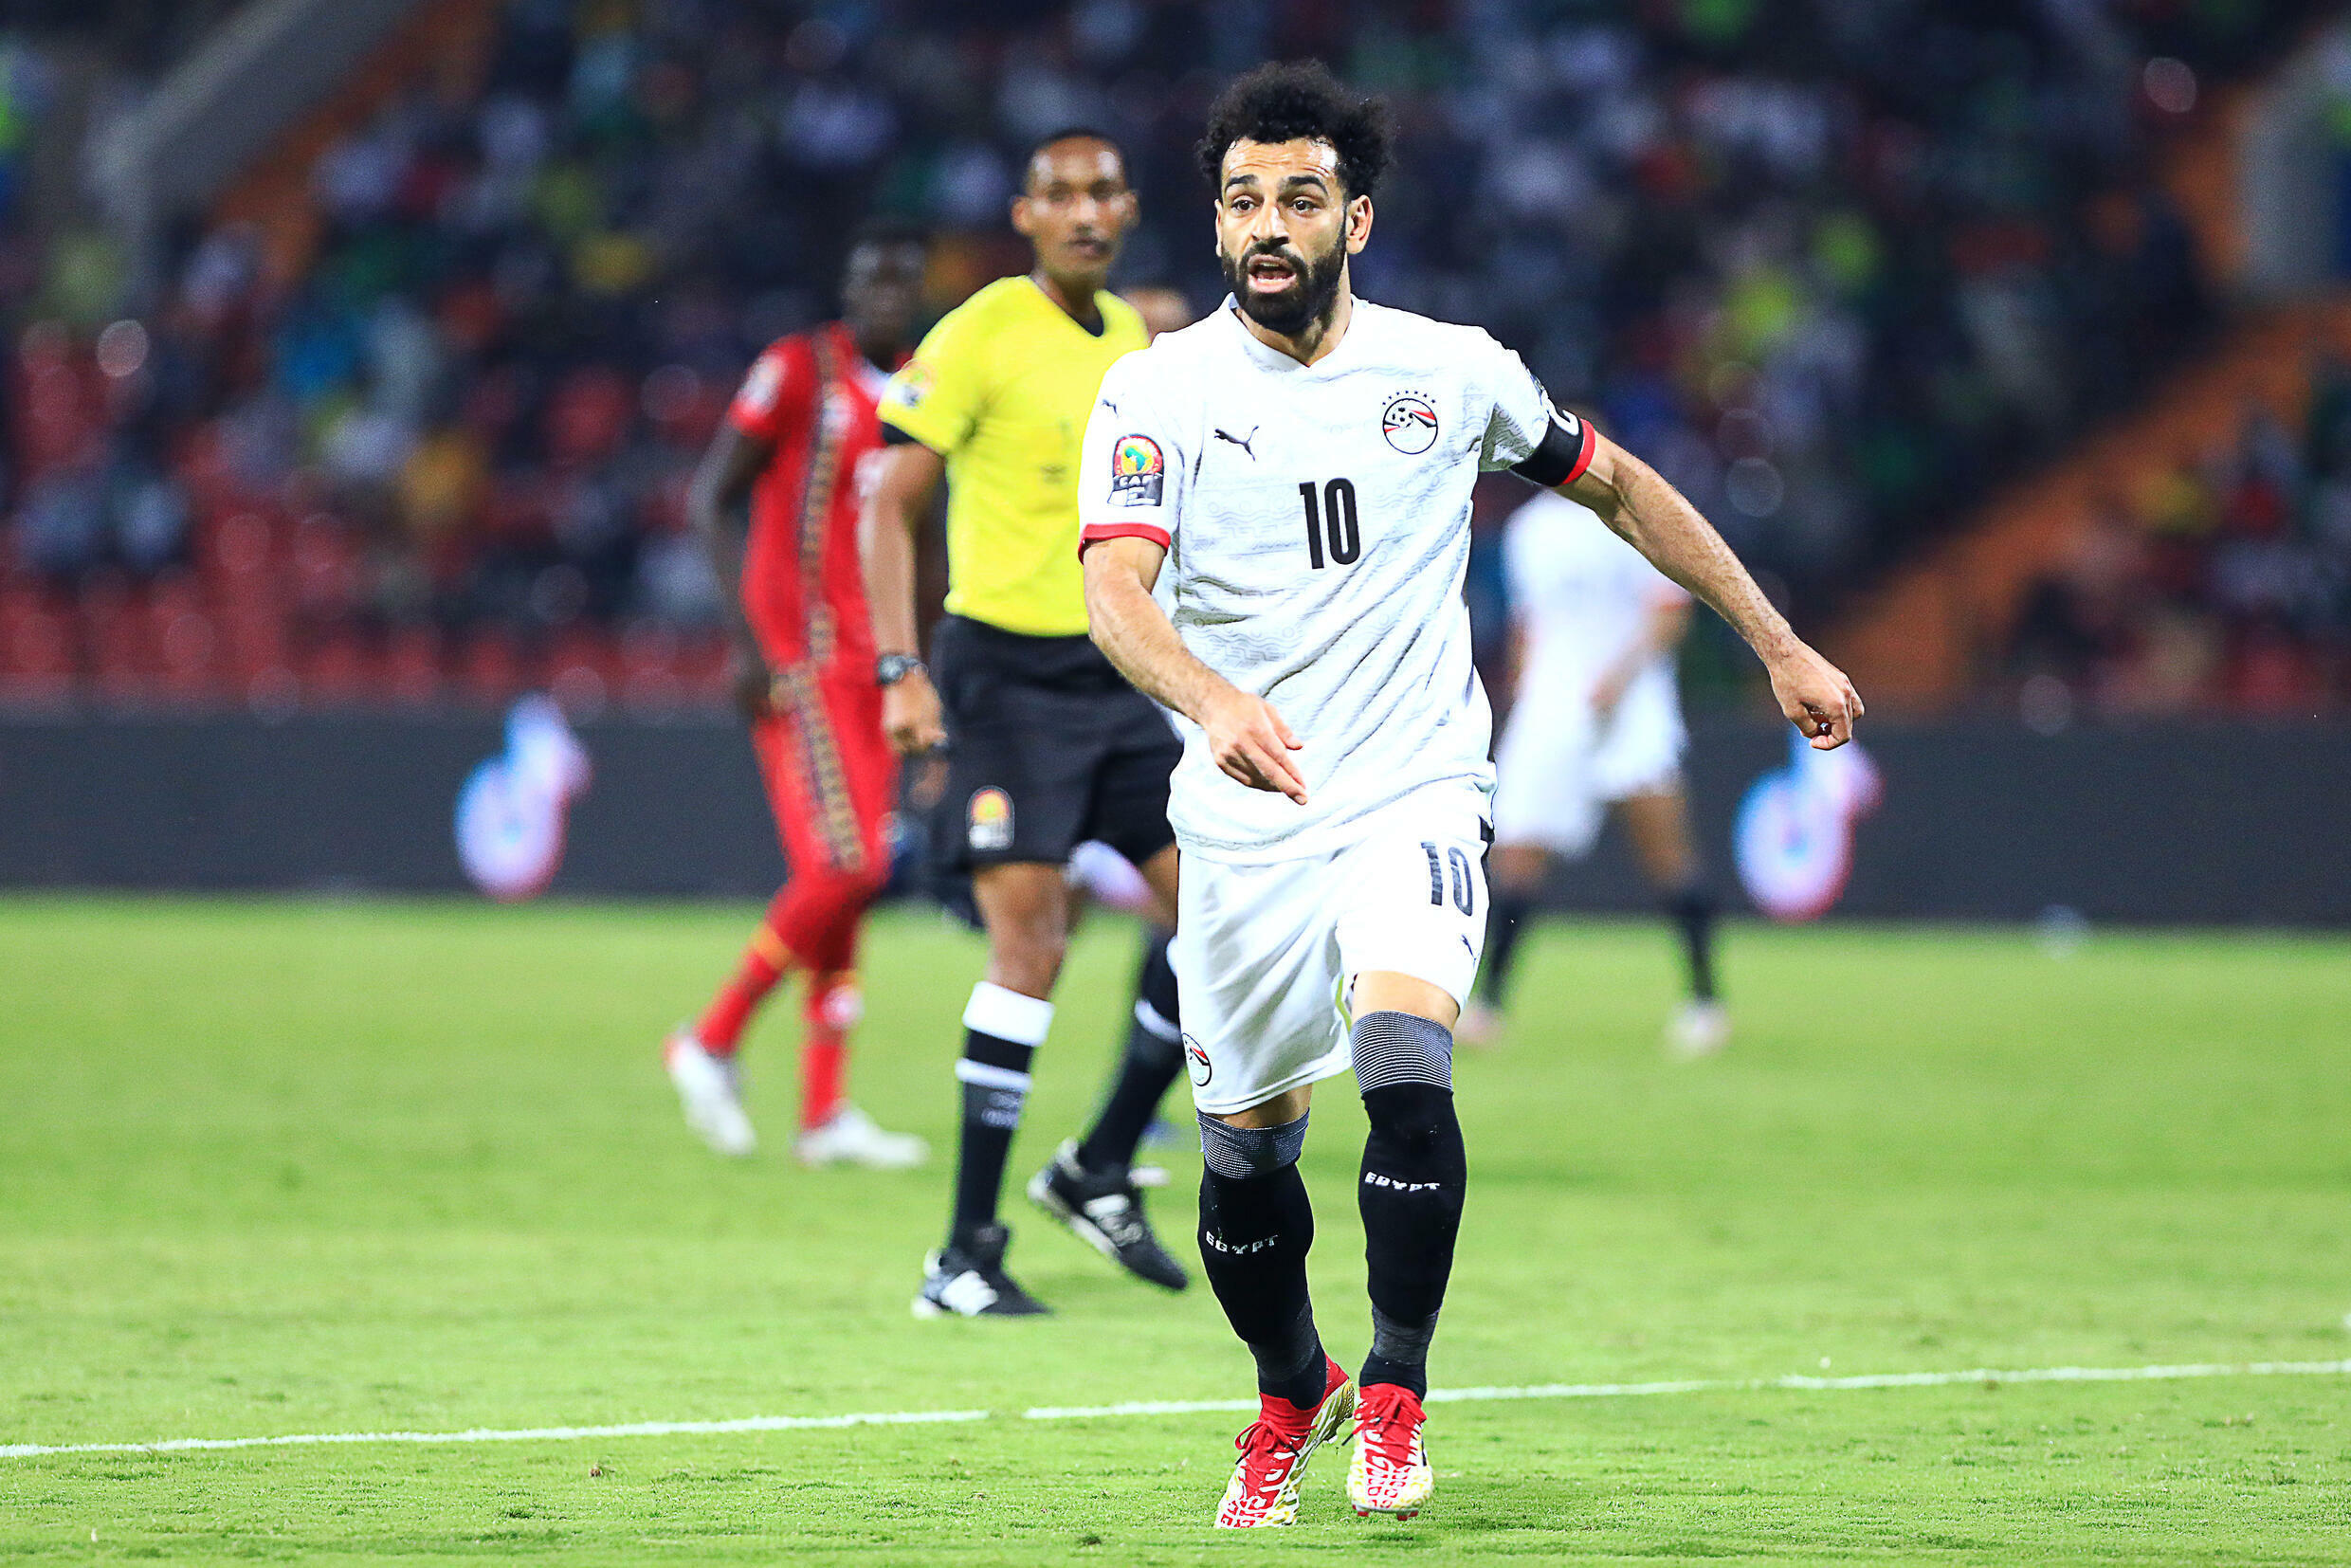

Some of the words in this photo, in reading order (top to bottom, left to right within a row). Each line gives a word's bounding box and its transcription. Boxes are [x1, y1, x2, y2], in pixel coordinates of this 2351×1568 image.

[1299, 478, 1360, 570] 10
[1420, 841, 1473, 917] 10
[1365, 1172, 1440, 1192] EGYPT
[1206, 1231, 1279, 1254] EGYPT
